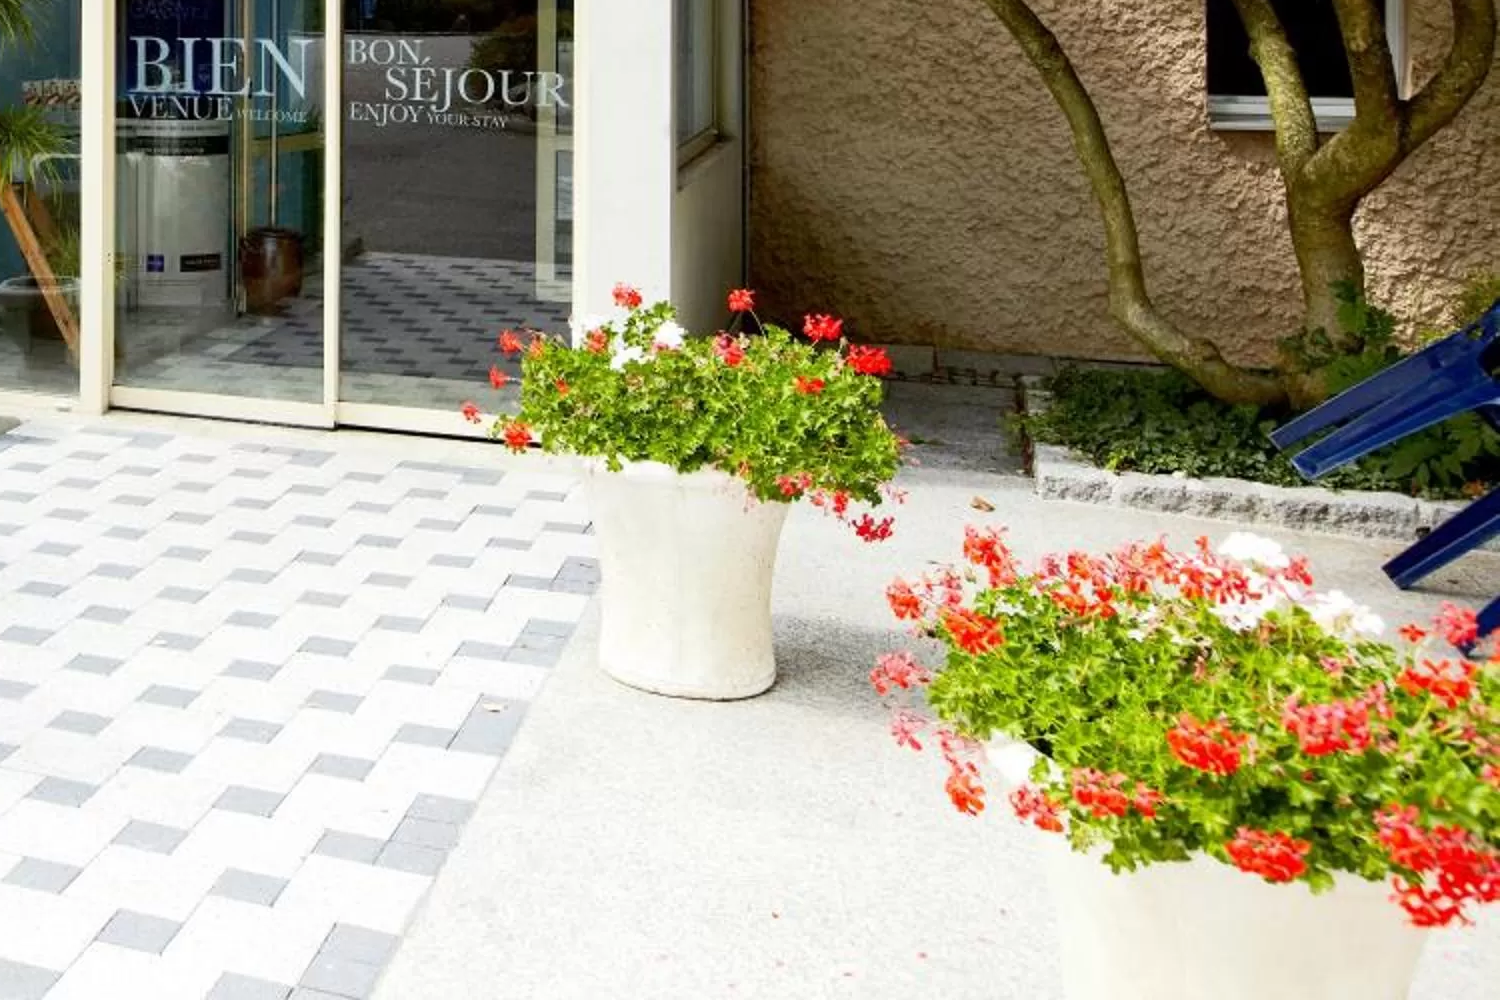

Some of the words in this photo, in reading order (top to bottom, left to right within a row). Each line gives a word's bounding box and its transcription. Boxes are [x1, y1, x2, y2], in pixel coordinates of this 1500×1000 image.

[349, 39, 424, 65] BON
[127, 35, 316, 99] BIEN
[385, 56, 569, 113] SÉJOUR
[128, 94, 233, 121] VENUE
[236, 108, 308, 123] WELCOME
[350, 102, 424, 127] ENJOY
[426, 111, 471, 125] YOUR
[472, 114, 510, 128] STAY
